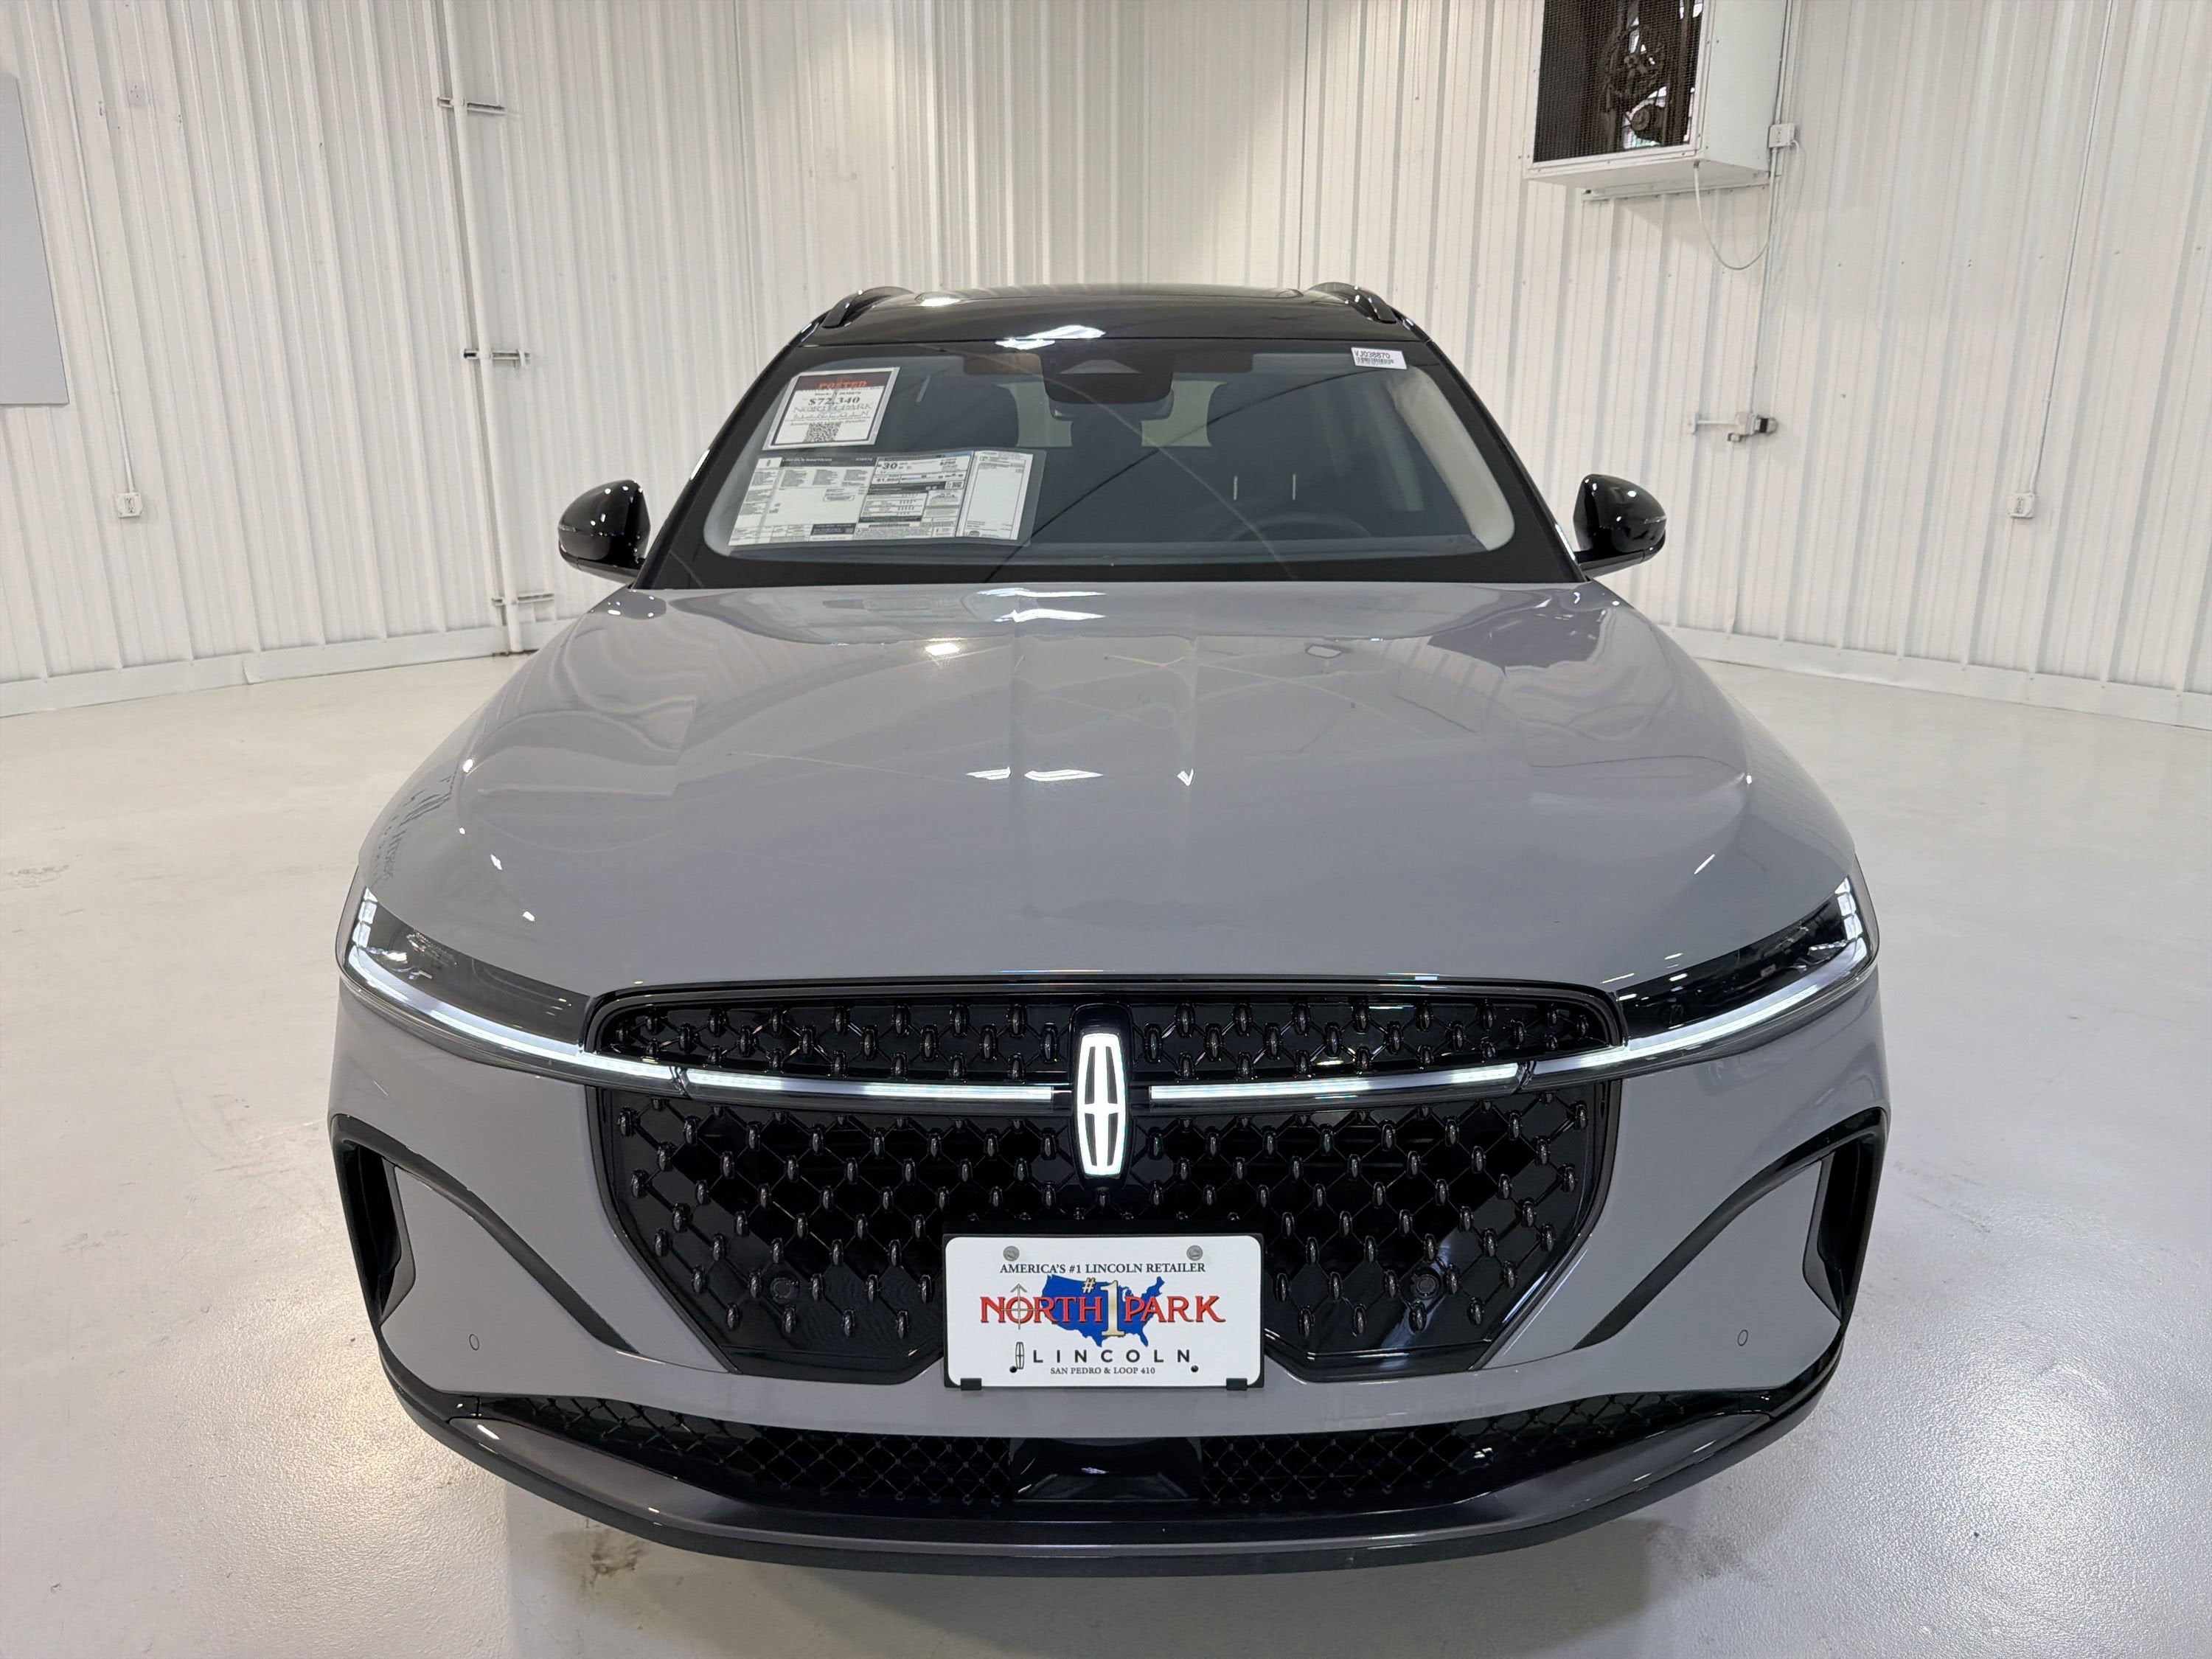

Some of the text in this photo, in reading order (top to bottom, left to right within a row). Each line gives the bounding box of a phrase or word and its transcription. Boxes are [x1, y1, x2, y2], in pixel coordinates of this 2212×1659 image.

[808, 396, 860, 406] $72,340
[999, 1262, 1206, 1273] AMERICA'S #1 LINCOLN RETAILER
[979, 1295, 1102, 1324] NORTH
[1124, 1295, 1226, 1324] PARK
[1033, 1349, 1190, 1363] LINCOLN
